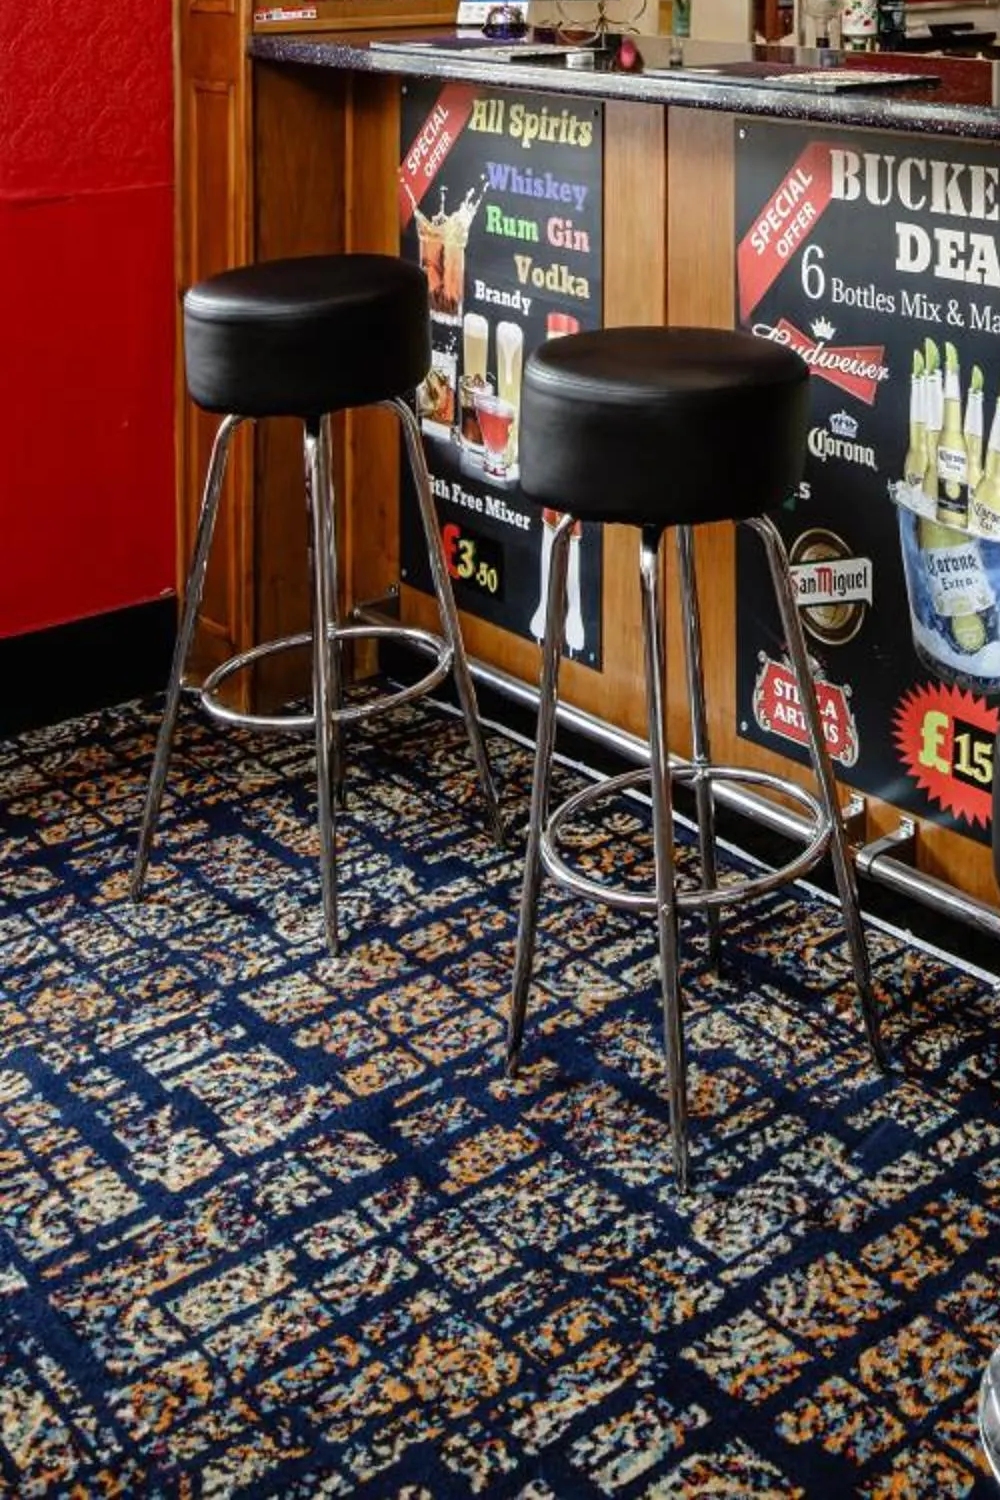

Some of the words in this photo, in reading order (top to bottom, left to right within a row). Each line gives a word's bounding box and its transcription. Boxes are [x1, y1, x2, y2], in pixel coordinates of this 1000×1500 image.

[406, 104, 450, 176] SPECIAL
[468, 99, 504, 134] All
[509, 103, 593, 148] Spirits
[423, 130, 452, 177] OFFER
[486, 161, 589, 211] Whiskey
[486, 205, 539, 242] Rum
[546, 217, 590, 253] Gin
[750, 167, 814, 255] SPECIAL
[775, 200, 817, 259] OFFER
[474, 279, 532, 316] Brandy
[513, 254, 590, 299] Vodka
[800, 244, 827, 300] 6
[831, 276, 896, 313] Bottles
[901, 290, 942, 325] Mix
[946, 299, 966, 328] &
[808, 427, 878, 472] Corona
[428, 473, 451, 500] ith
[452, 483, 483, 512] Free
[485, 496, 532, 531] Mixer
[773, 701, 839, 744] ARTIS
